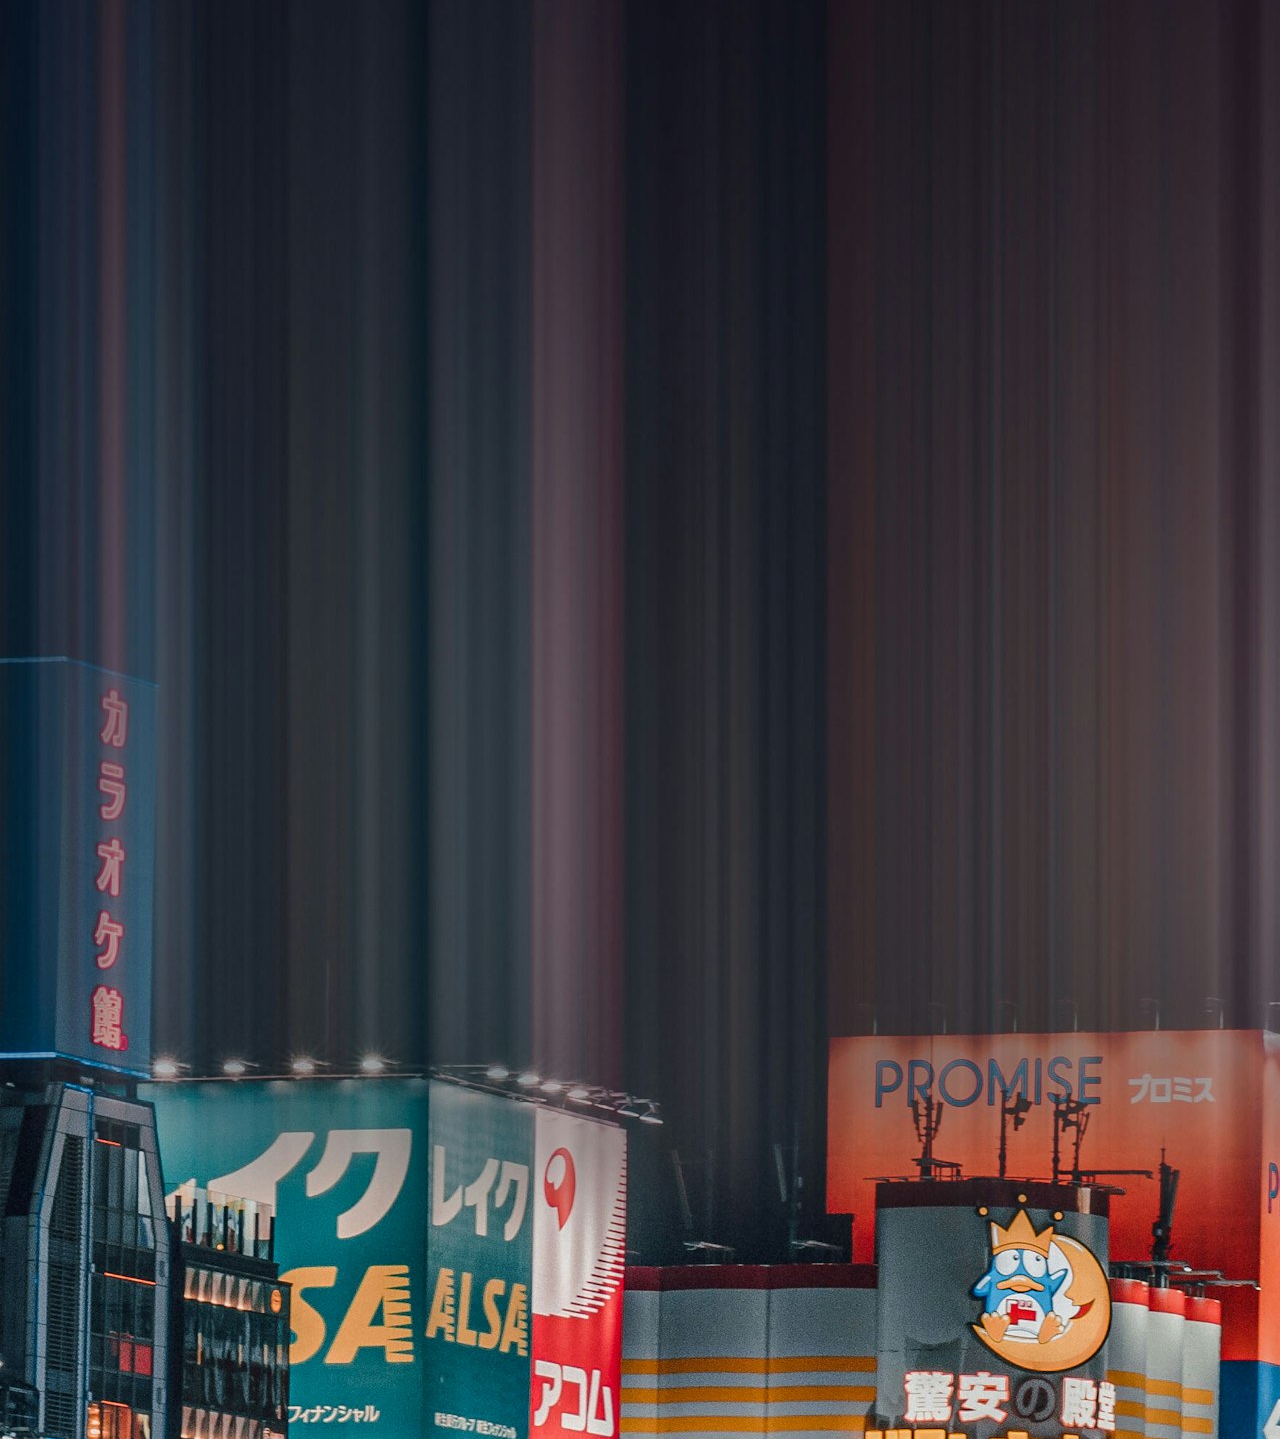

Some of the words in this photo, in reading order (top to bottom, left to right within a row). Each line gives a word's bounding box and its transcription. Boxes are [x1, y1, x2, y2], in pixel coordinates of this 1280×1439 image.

[92, 688, 130, 1051] カラオケ館
[874, 1056, 1104, 1108] PROMISE
[1128, 1073, 1217, 1104] プロミス
[433, 1145, 529, 1241] レイク
[426, 1267, 528, 1358] ALSA
[533, 1360, 615, 1436] アコム
